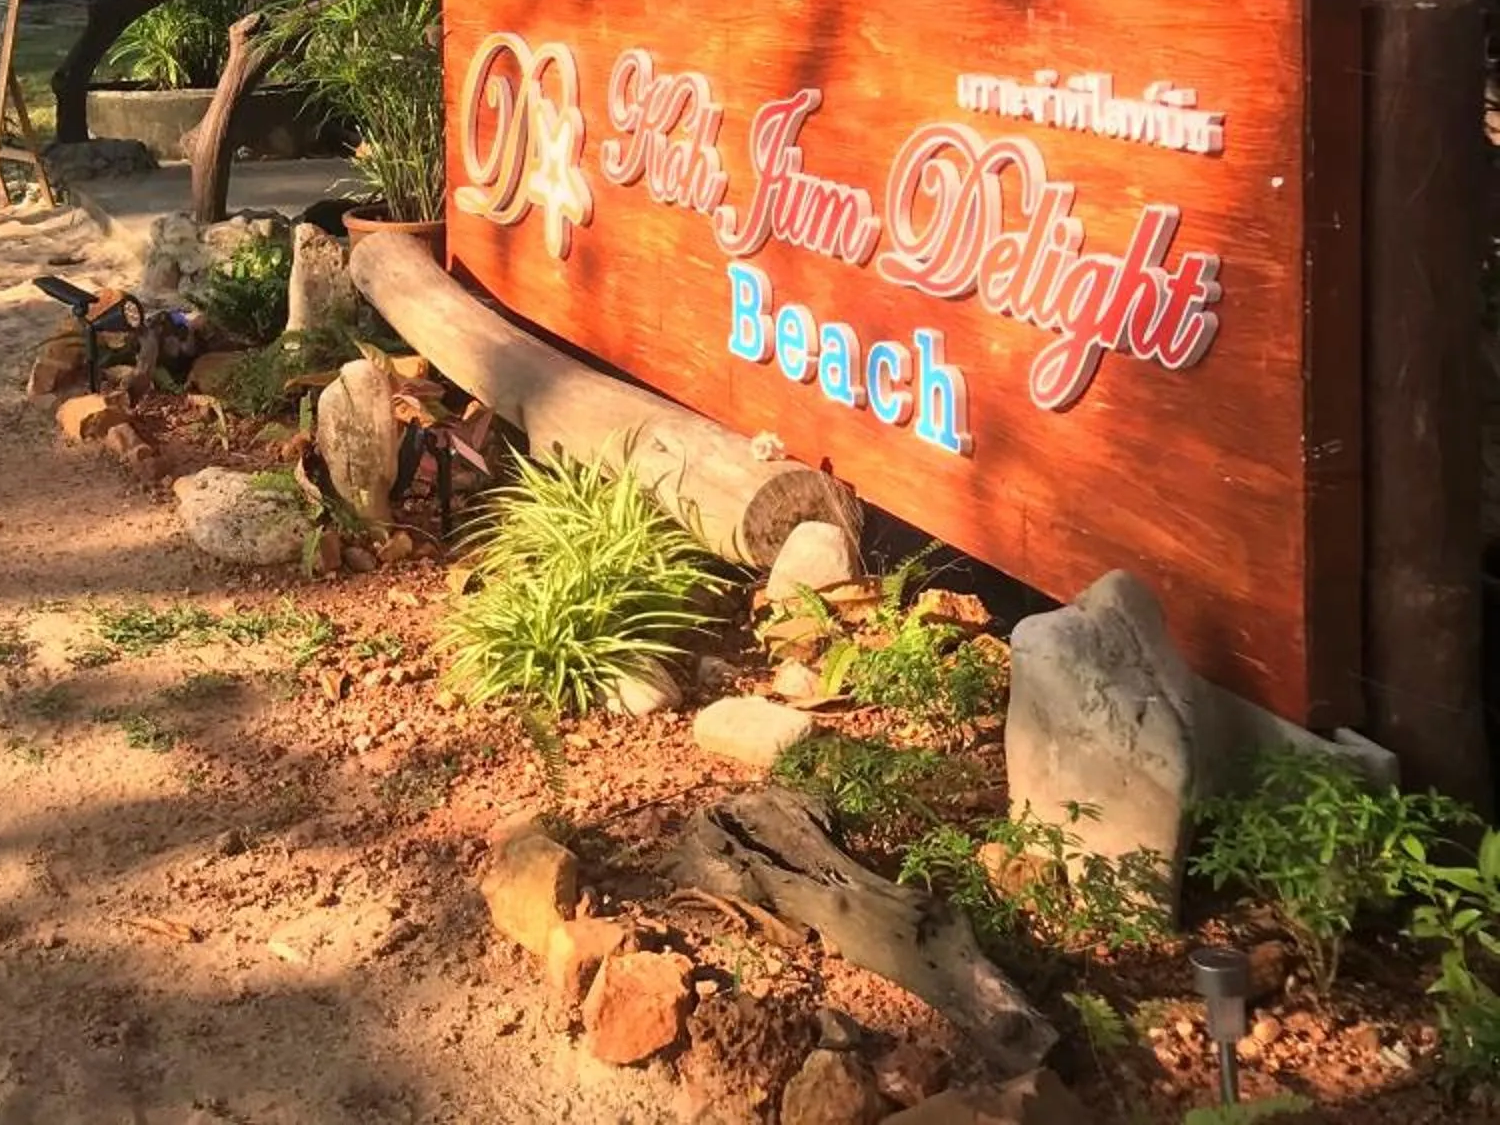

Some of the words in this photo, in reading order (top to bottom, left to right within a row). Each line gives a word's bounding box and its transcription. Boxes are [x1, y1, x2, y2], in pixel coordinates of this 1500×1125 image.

[602, 47, 730, 215] Koh
[712, 88, 882, 267] Jum
[876, 121, 1223, 412] Delight
[727, 258, 975, 455] Beach
